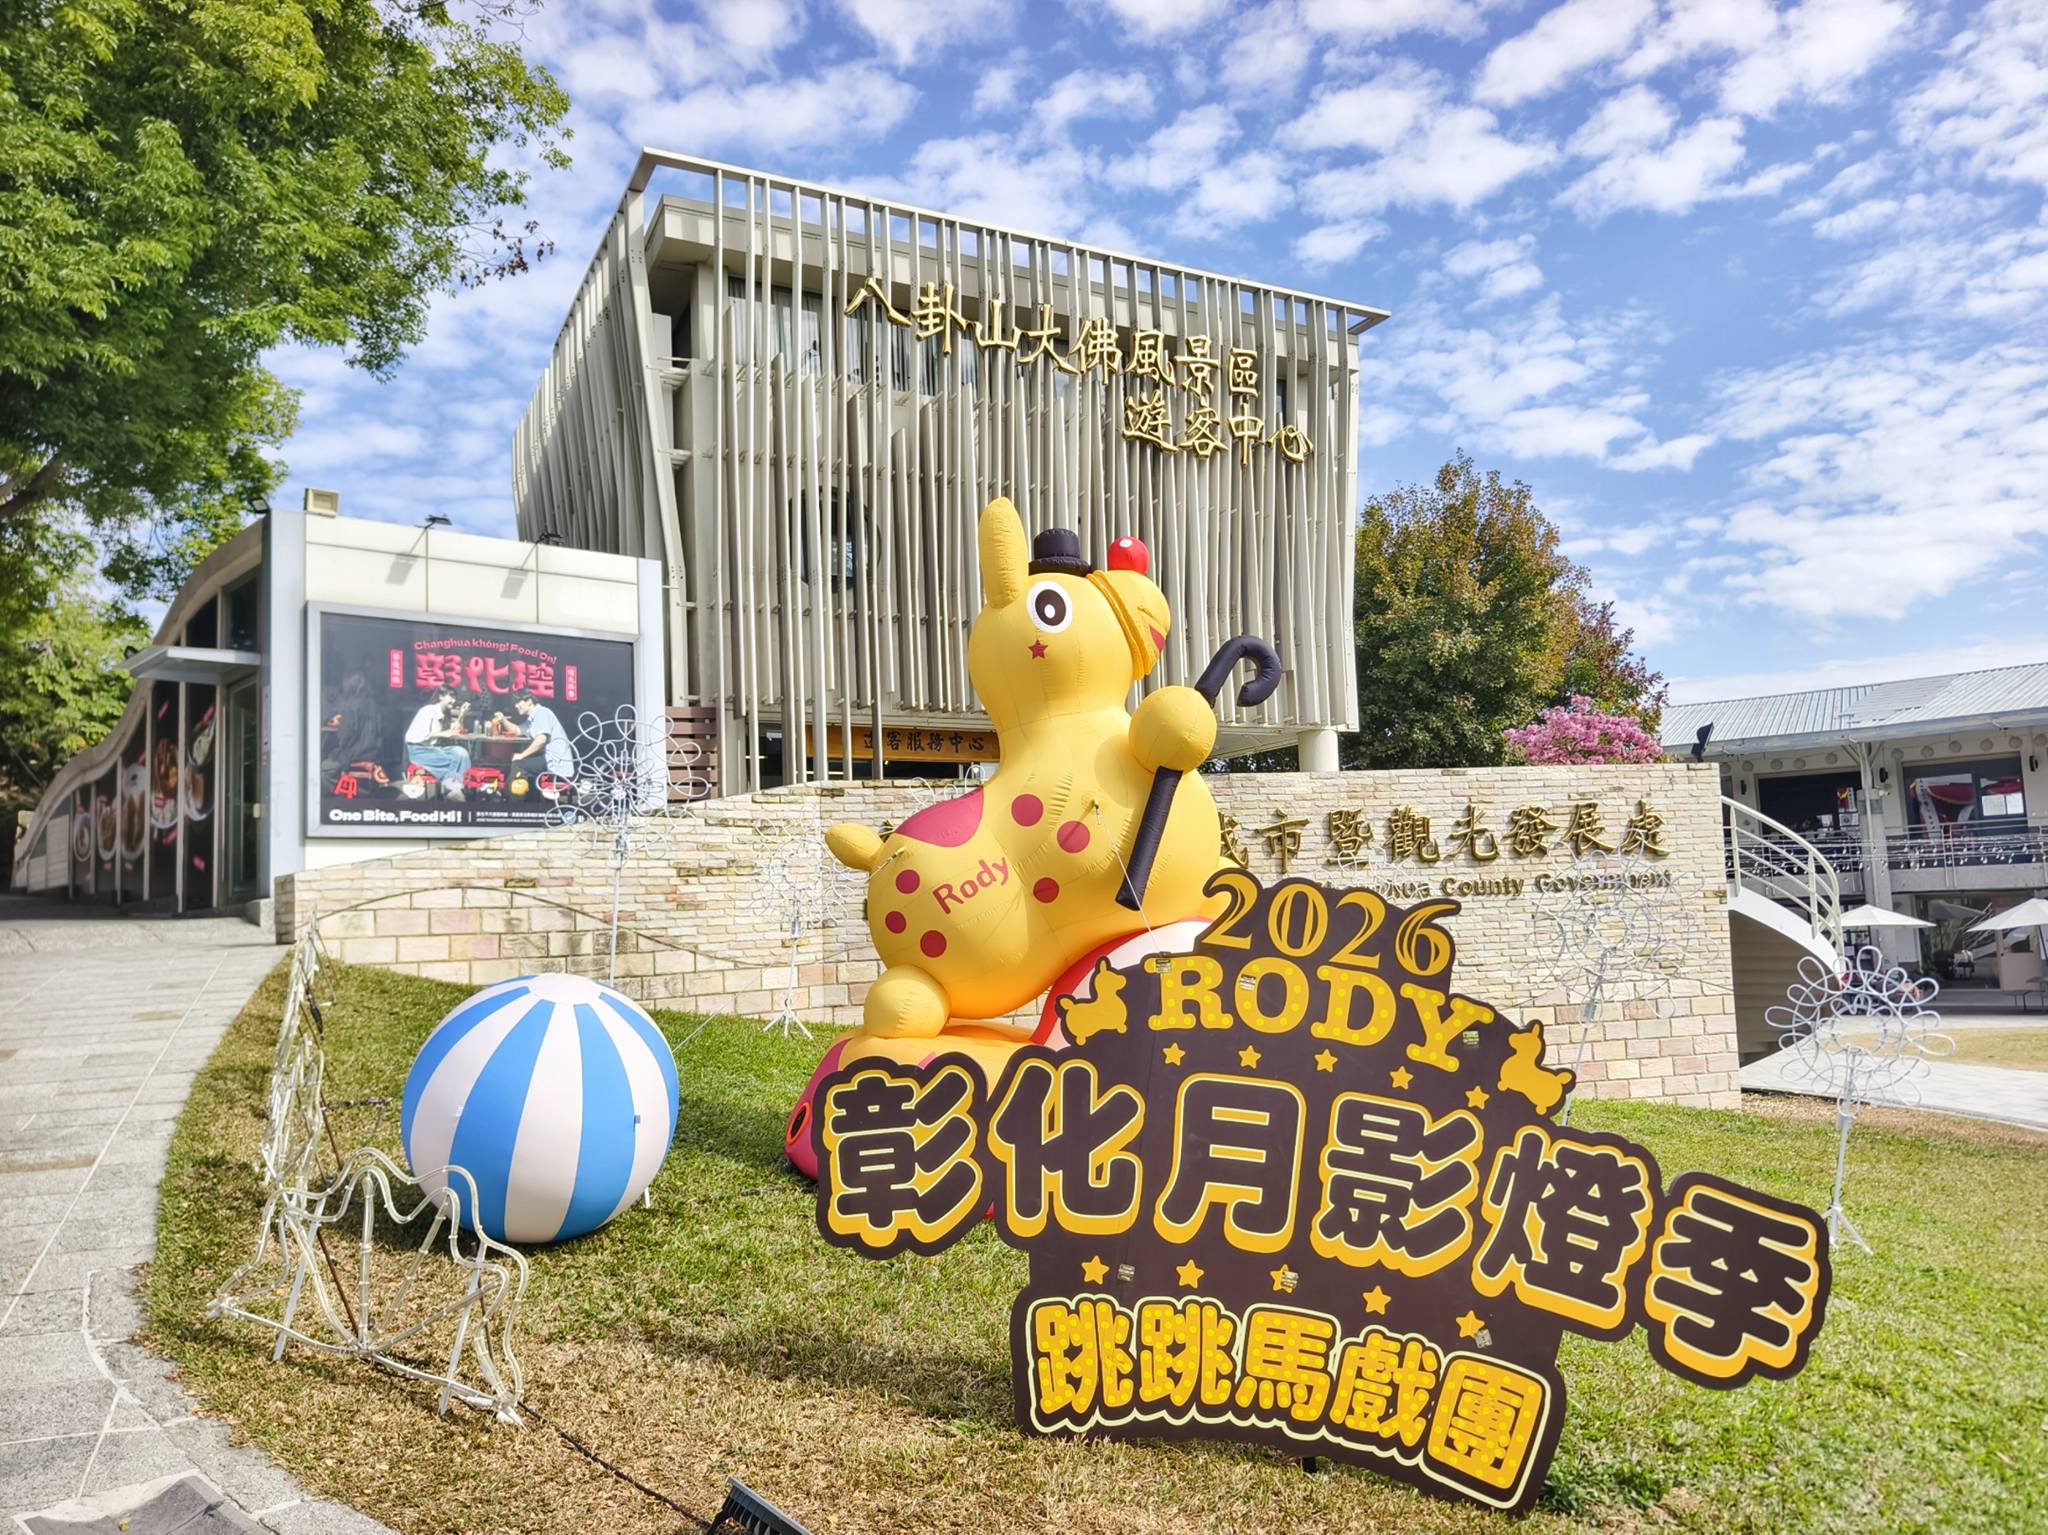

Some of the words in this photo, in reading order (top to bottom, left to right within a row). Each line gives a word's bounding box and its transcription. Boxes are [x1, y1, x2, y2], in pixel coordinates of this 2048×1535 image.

[843, 277, 1259, 396] 八卦山大佛風景區
[1121, 390, 1315, 466] 遊客中心
[415, 638, 471, 649] Changhua
[510, 643, 538, 657] Food
[539, 652, 557, 664] On!
[329, 809, 361, 821] One
[363, 809, 398, 823] Bite,
[400, 810, 438, 822] Food
[932, 857, 1009, 915] Rody
[1202, 872, 1457, 977] 2026
[1441, 875, 1525, 898] County
[1144, 955, 1494, 1073] RODY
[822, 1055, 1821, 1379] 彰化月影燈季
[1035, 1299, 1544, 1489] 跳跳馬戲團
